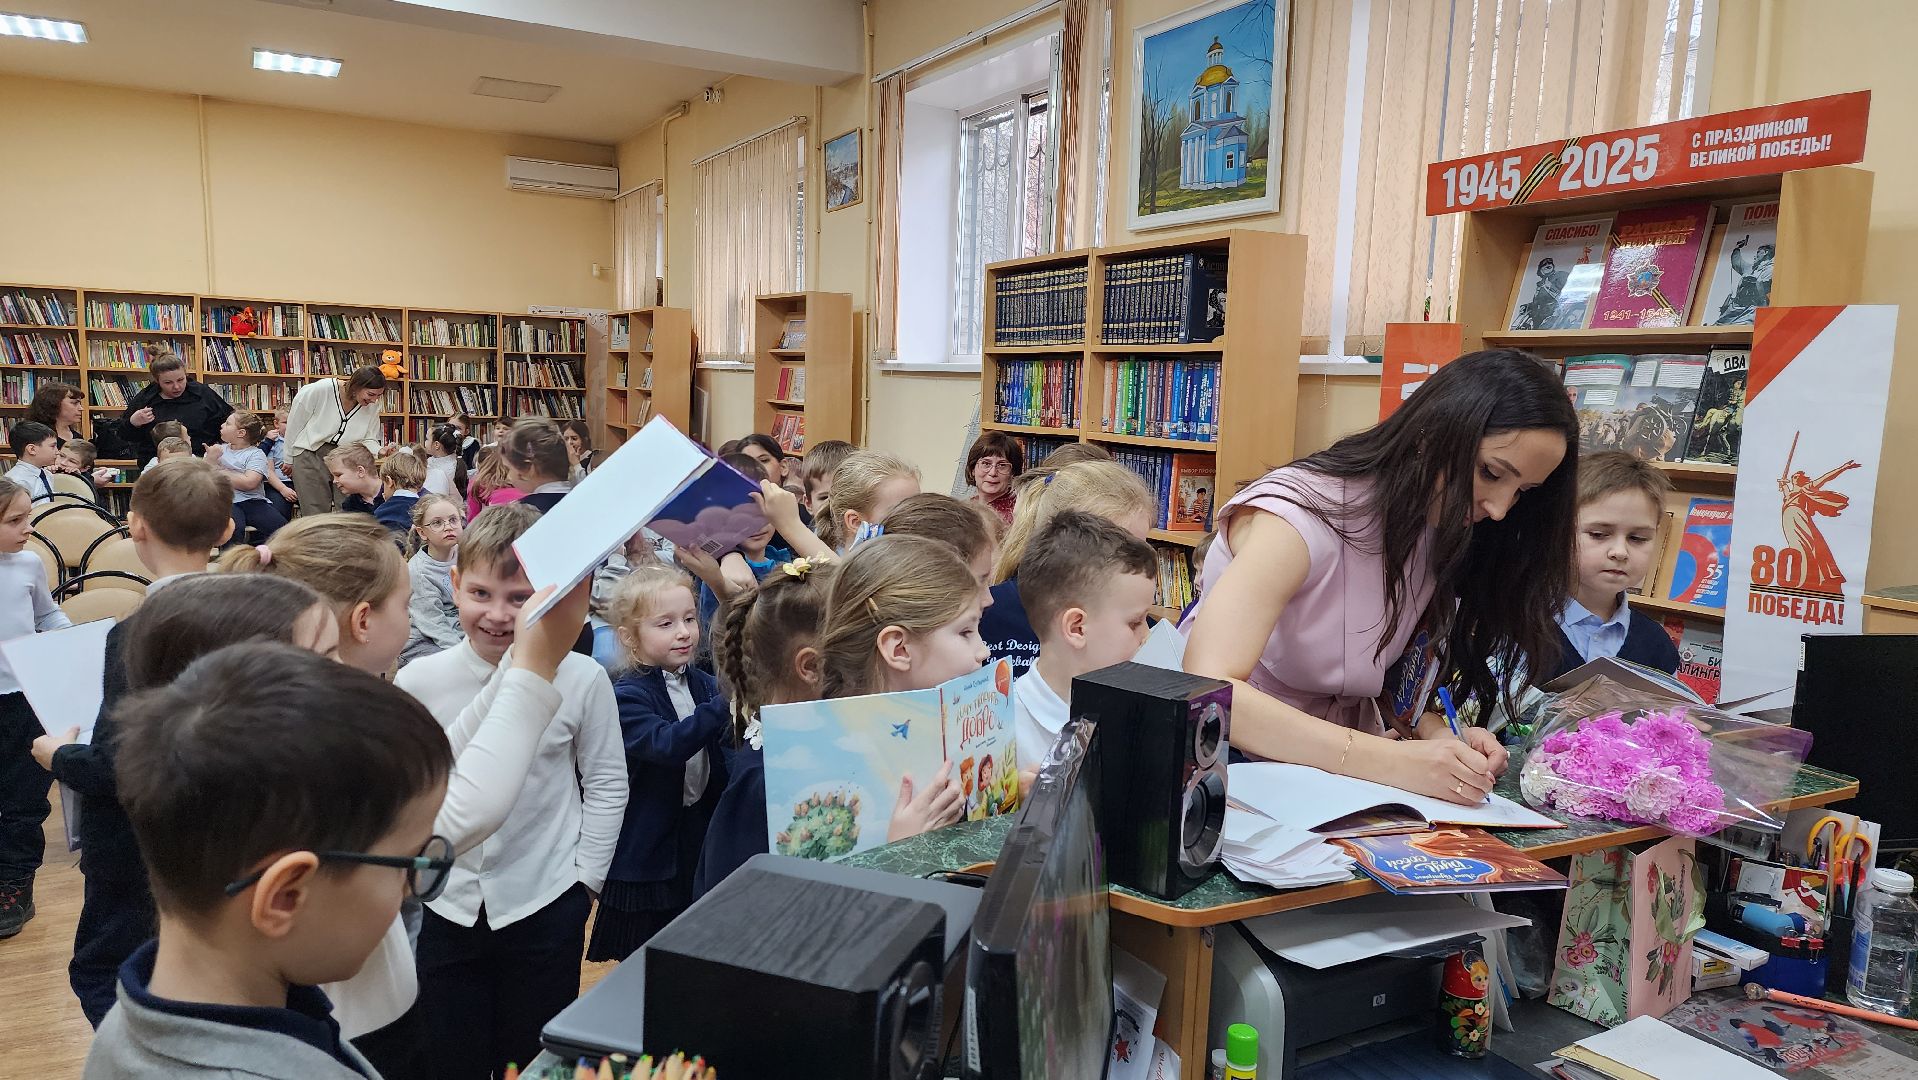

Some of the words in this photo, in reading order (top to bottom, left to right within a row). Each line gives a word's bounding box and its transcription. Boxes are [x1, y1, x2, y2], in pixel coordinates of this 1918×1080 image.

[1692, 132, 1702, 148] С
[1704, 117, 1809, 146] ПРАЗДНИКОМ
[1689, 142, 1757, 168] ВЕЛИКОЙ
[1760, 134, 1833, 159] ПОБЕДЫ!
[1442, 155, 1522, 208] 1945
[1558, 133, 1661, 192] 2025
[1744, 203, 1779, 220] ПОМ
[1545, 224, 1600, 240] СПАСИБО!
[1704, 563, 1725, 580] 55
[1751, 544, 1803, 588] 80
[1748, 592, 1844, 625] ПОБЕДА!
[1006, 639, 1040, 654] Desig
[1677, 664, 1721, 680] АЛИНГР
